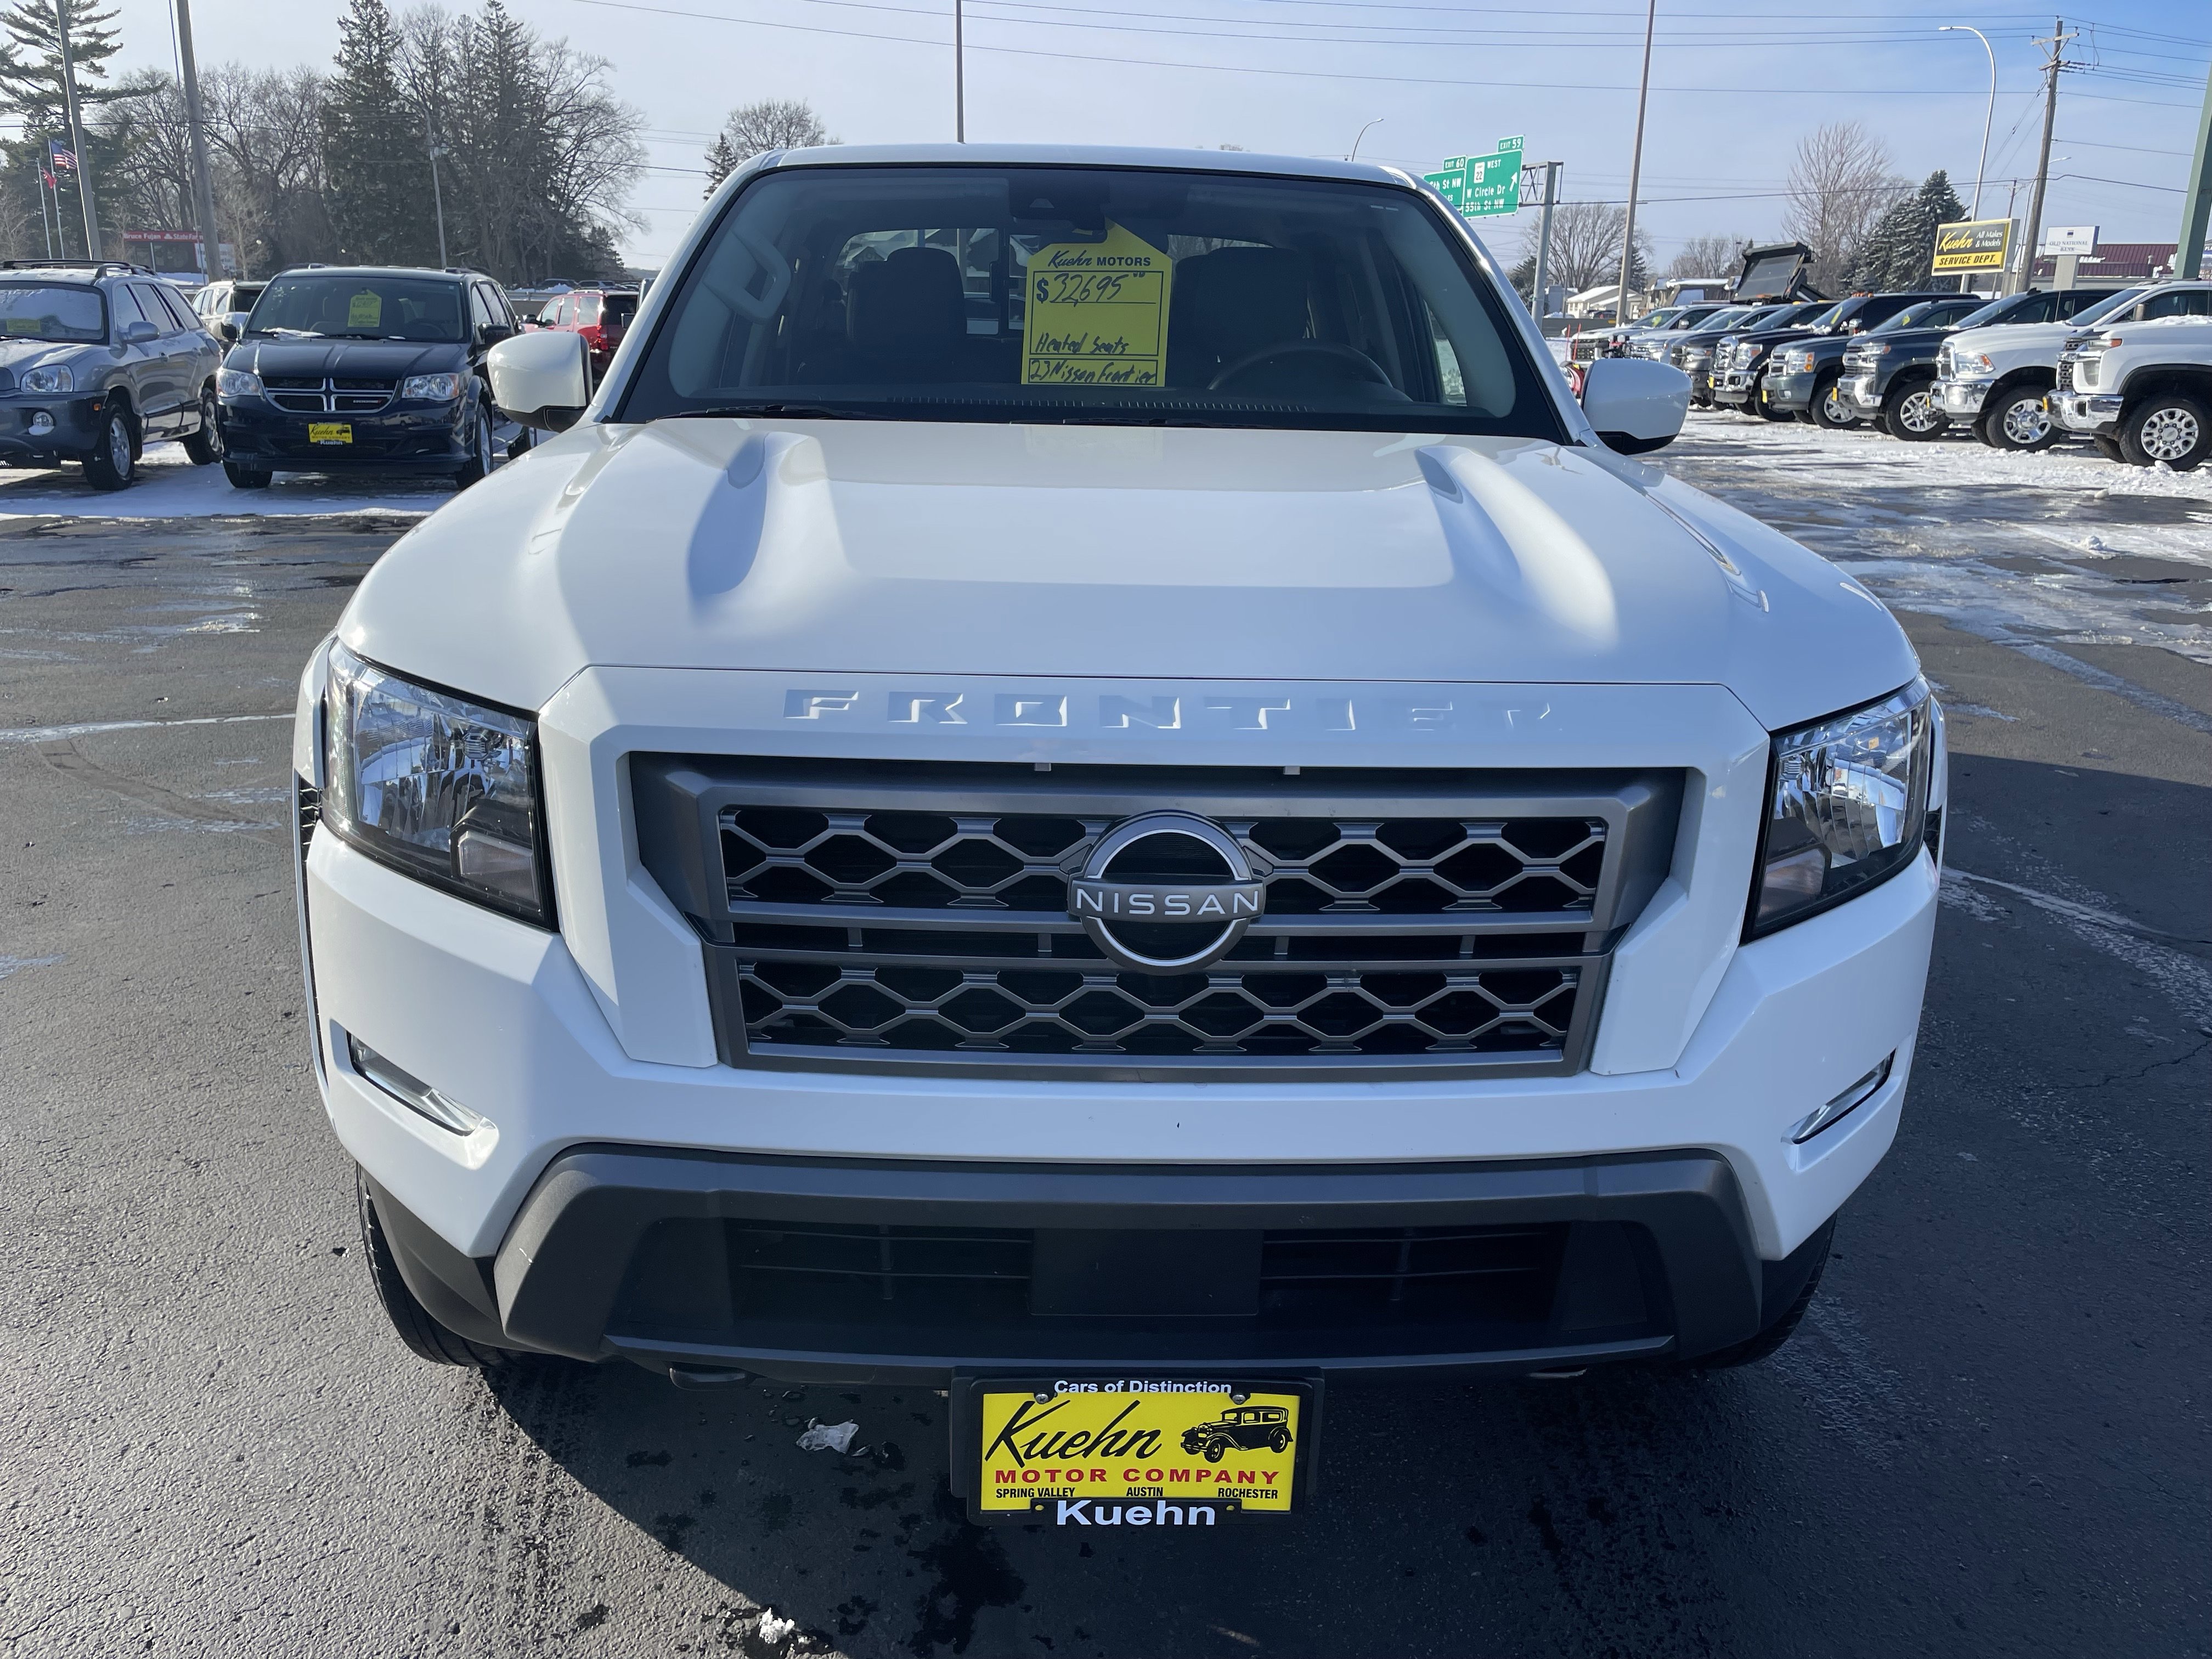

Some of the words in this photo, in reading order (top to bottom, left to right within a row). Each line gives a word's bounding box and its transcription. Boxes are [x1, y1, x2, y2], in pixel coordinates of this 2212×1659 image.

[1500, 141, 1511, 149] EXIT
[1512, 138, 1521, 149] 59
[1456, 159, 1464, 168] 60
[1487, 159, 1501, 168] WEST
[1475, 171, 1483, 180] 22
[1442, 179, 1450, 190] St
[1452, 177, 1462, 188] NW
[1466, 188, 1472, 199] W
[1475, 186, 1494, 198] Circle
[1497, 184, 1506, 195] Dr
[1465, 201, 1481, 213] 55th
[1483, 200, 1492, 211] St
[1493, 198, 1505, 210] NW
[1938, 229, 1973, 252] Kuehn
[1985, 230, 2003, 238] Makes
[1981, 238, 2001, 247] Models
[1048, 250, 1092, 268] Kuehn
[1097, 256, 1150, 267] MOTORS
[1939, 256, 1972, 266] SERVICE
[1973, 254, 1996, 264] DEPT.
[1035, 332, 1088, 354] Heated
[1090, 336, 1129, 354] Seats
[311, 425, 333, 436] Kuehn
[783, 689, 1562, 732] FRONTIER
[1076, 888, 1259, 916] NISSAN
[1054, 1380, 1098, 1393] Cars
[1104, 1380, 1124, 1393] of
[1129, 1380, 1232, 1393] Distinction
[984, 1400, 1162, 1468] Kuehn
[995, 1469, 1107, 1483] MOTOR
[1123, 1469, 1279, 1485] COMPANY
[996, 1488, 1035, 1498] SPRING
[1037, 1487, 1075, 1497] VALLEY
[1126, 1487, 1163, 1497] AUSTIN
[1218, 1487, 1278, 1499] ROCHESTER
[1057, 1500, 1215, 1525] Kuehn
